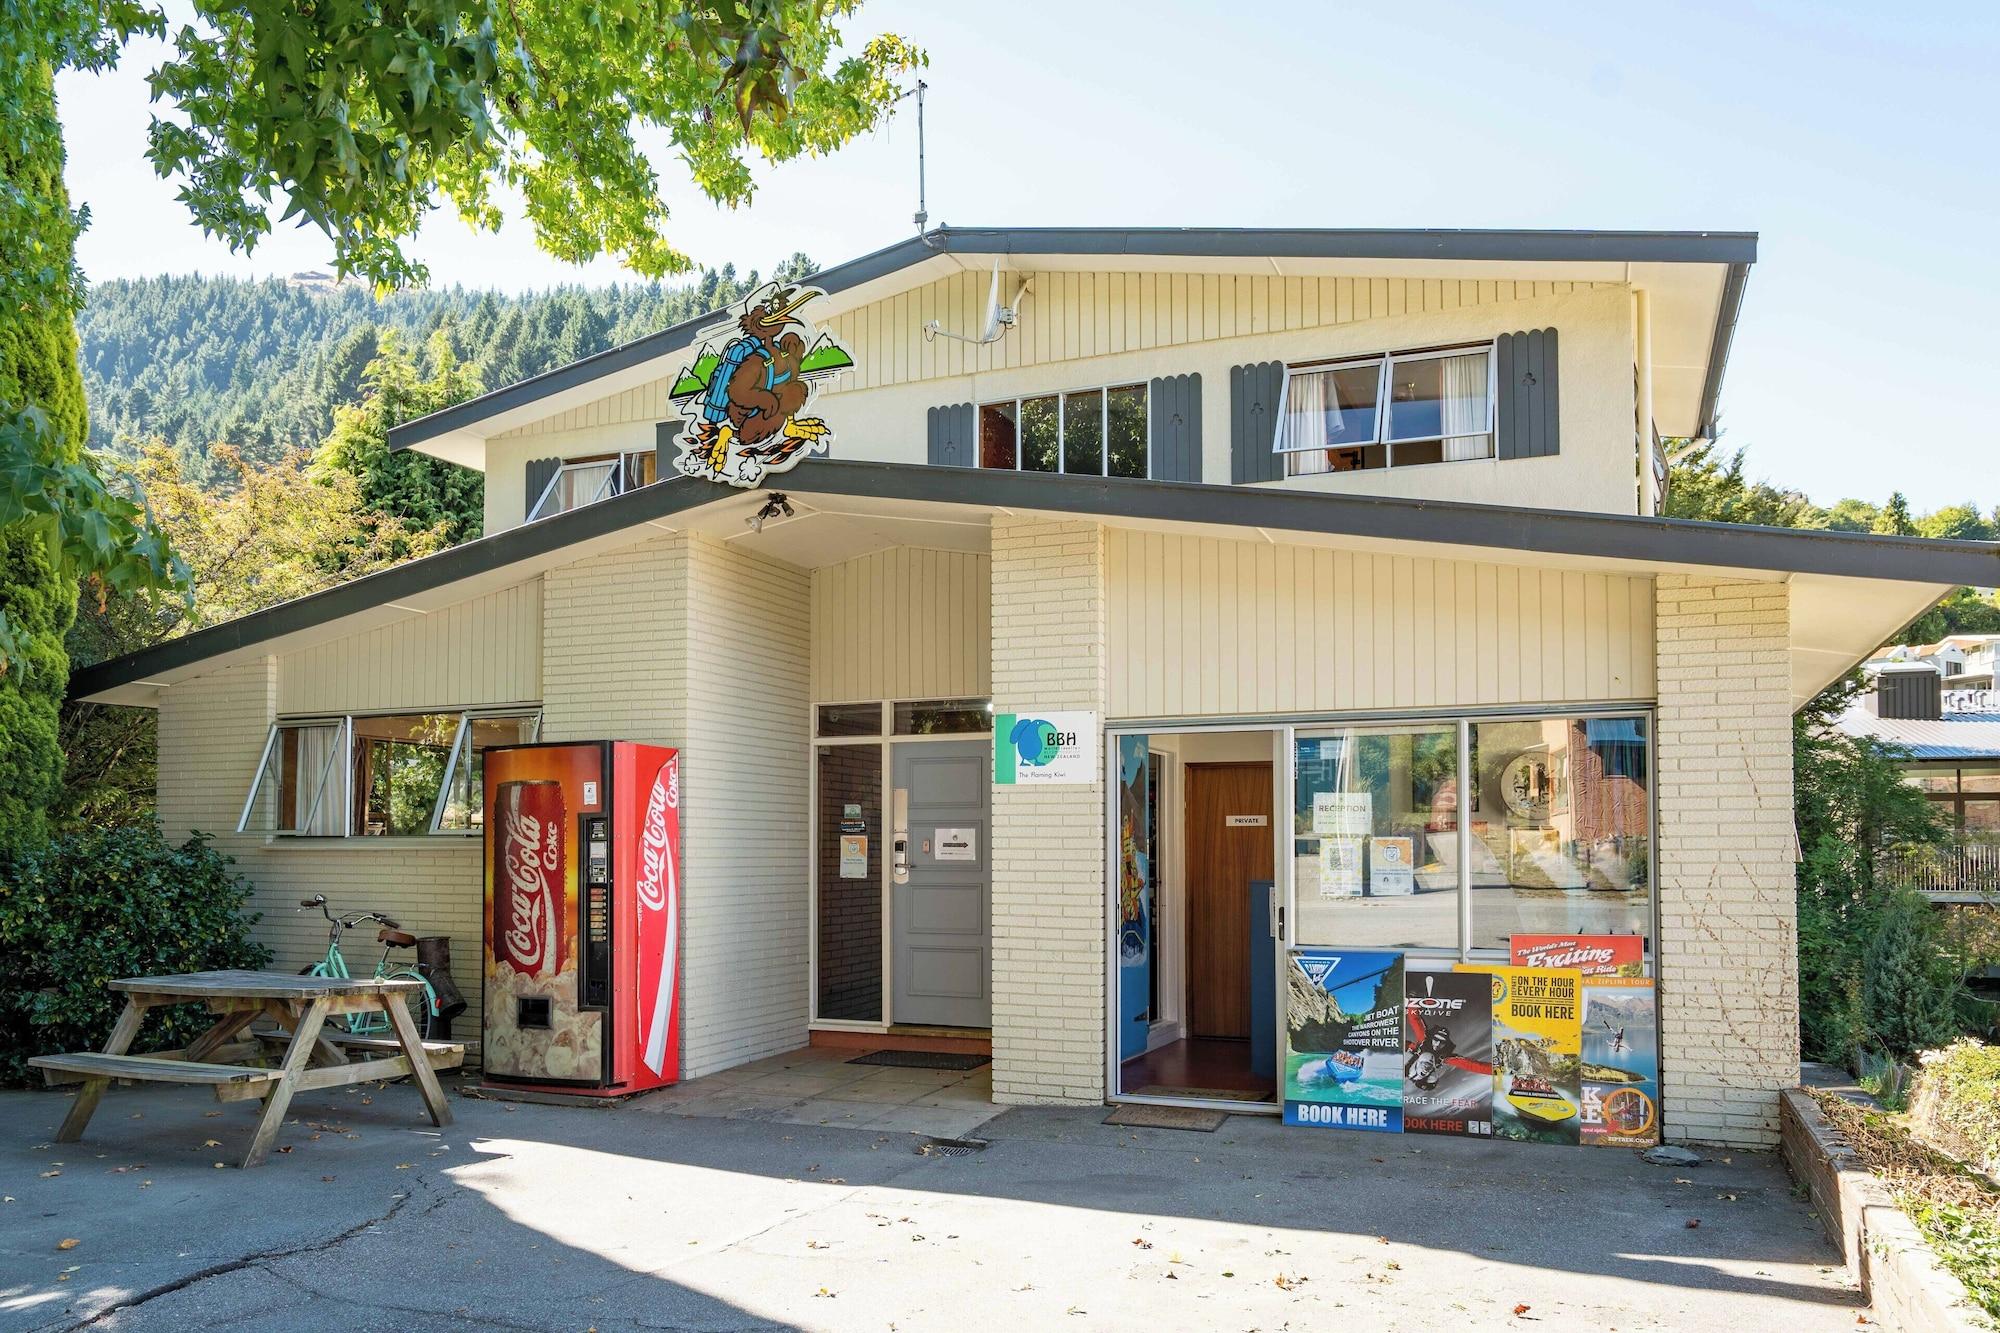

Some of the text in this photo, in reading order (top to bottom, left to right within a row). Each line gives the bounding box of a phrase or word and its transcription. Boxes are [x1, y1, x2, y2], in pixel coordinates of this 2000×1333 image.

[1047, 732, 1076, 746] BBH
[1031, 771, 1052, 779] Flaming
[666, 767, 678, 809] Coke
[1318, 804, 1366, 812] RECEPTION
[543, 821, 557, 871] Coke
[637, 782, 666, 911] Coca-Cola
[505, 811, 541, 966] Coca-Cola
[1517, 949, 1530, 957] The
[1526, 946, 1615, 967] Exciting
[1596, 965, 1617, 974] Ride
[1518, 976, 1574, 988] ON THE HOUR
[1518, 986, 1574, 998] EVERY HOUR
[1364, 1005, 1400, 1022] JET BOAT
[1512, 1004, 1574, 1020] BOOK HERE
[1360, 1016, 1400, 1031] NARROWEST
[1348, 1026, 1399, 1038] CANYONS ON THE
[1371, 1037, 1399, 1048] RIVER
[1404, 1096, 1478, 1108] RACE THE FEAR
[1298, 1104, 1388, 1128] BOOK HERE
[1405, 1117, 1463, 1132] OOK HERE
